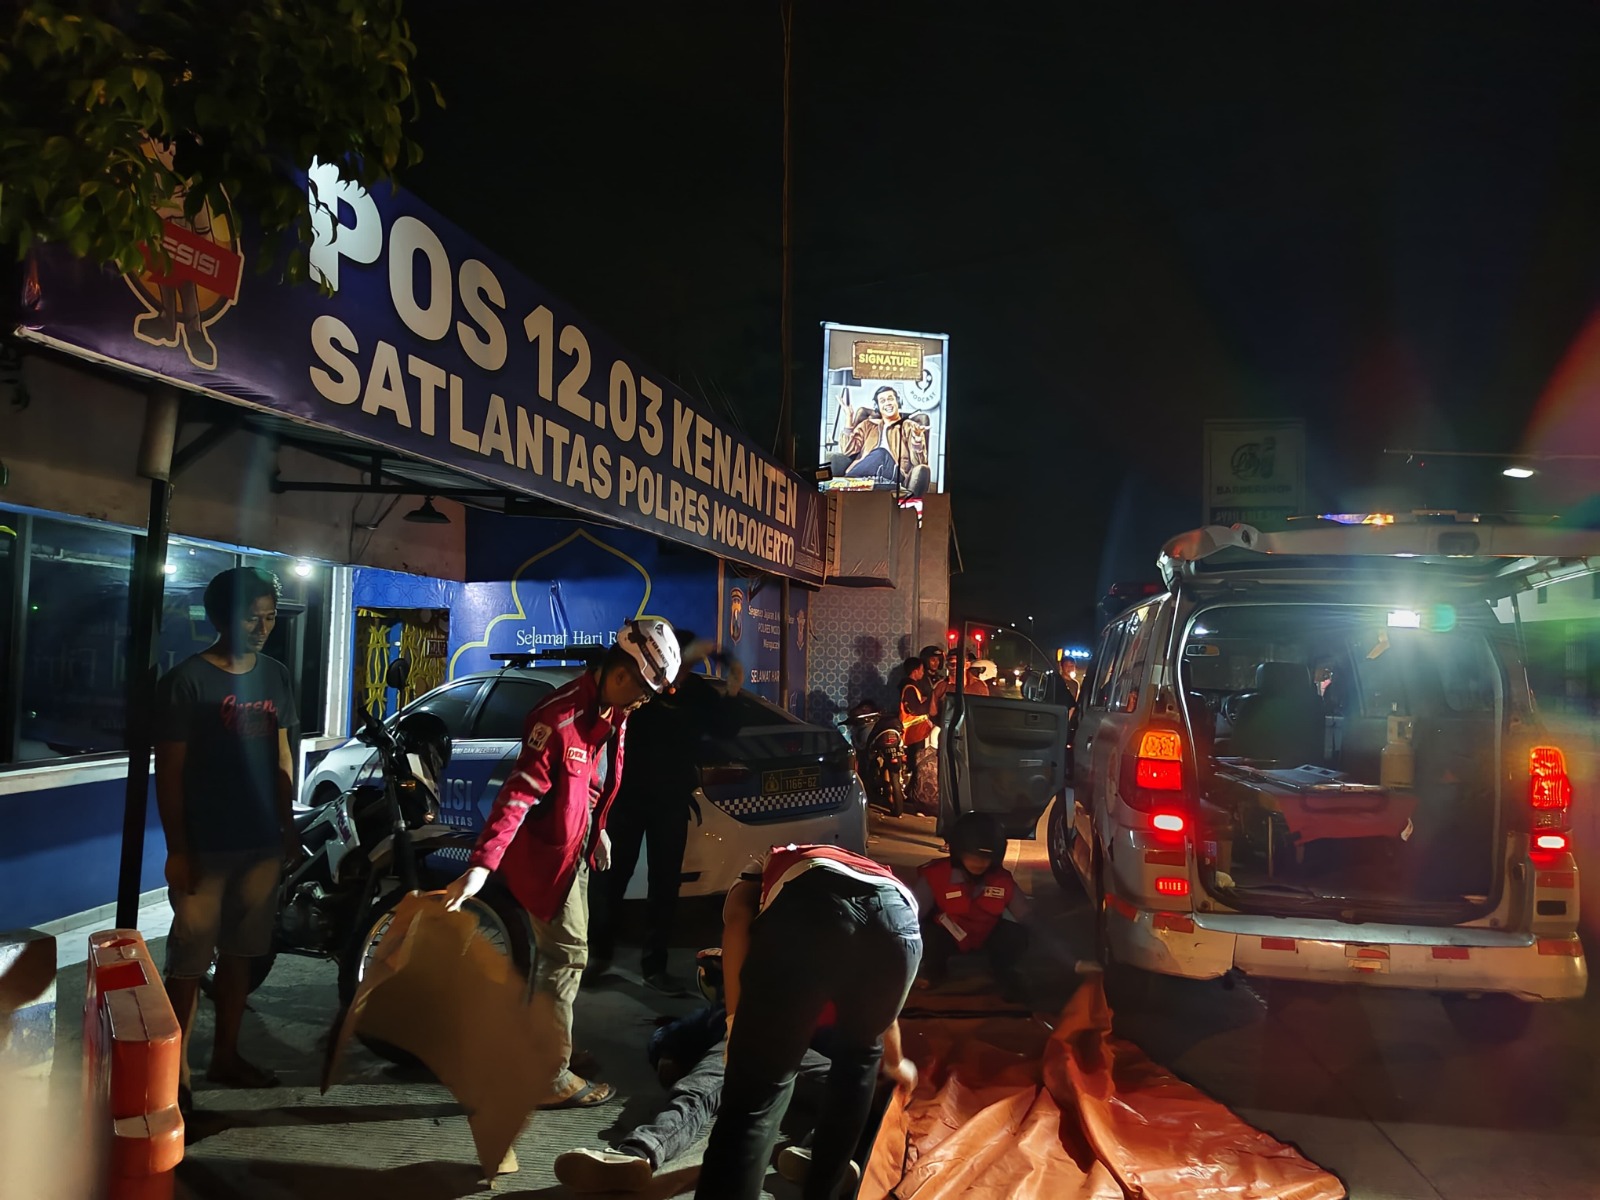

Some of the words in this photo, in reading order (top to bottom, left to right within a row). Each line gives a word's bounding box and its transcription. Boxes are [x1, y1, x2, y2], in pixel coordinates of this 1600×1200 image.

[156, 235, 220, 279] ESISI
[308, 154, 507, 371] POS
[523, 304, 664, 456] 12.03
[672, 398, 798, 529] KENANTEN
[858, 353, 918, 368] SIGNATURE
[910, 390, 936, 403] PODCAST
[310, 315, 612, 500] SATLANTAS
[619, 455, 709, 537] POLRES
[712, 500, 795, 568] MOJOKERTO
[516, 626, 568, 648] Selamat
[573, 630, 602, 645] Hari
[440, 778, 473, 811] ISI
